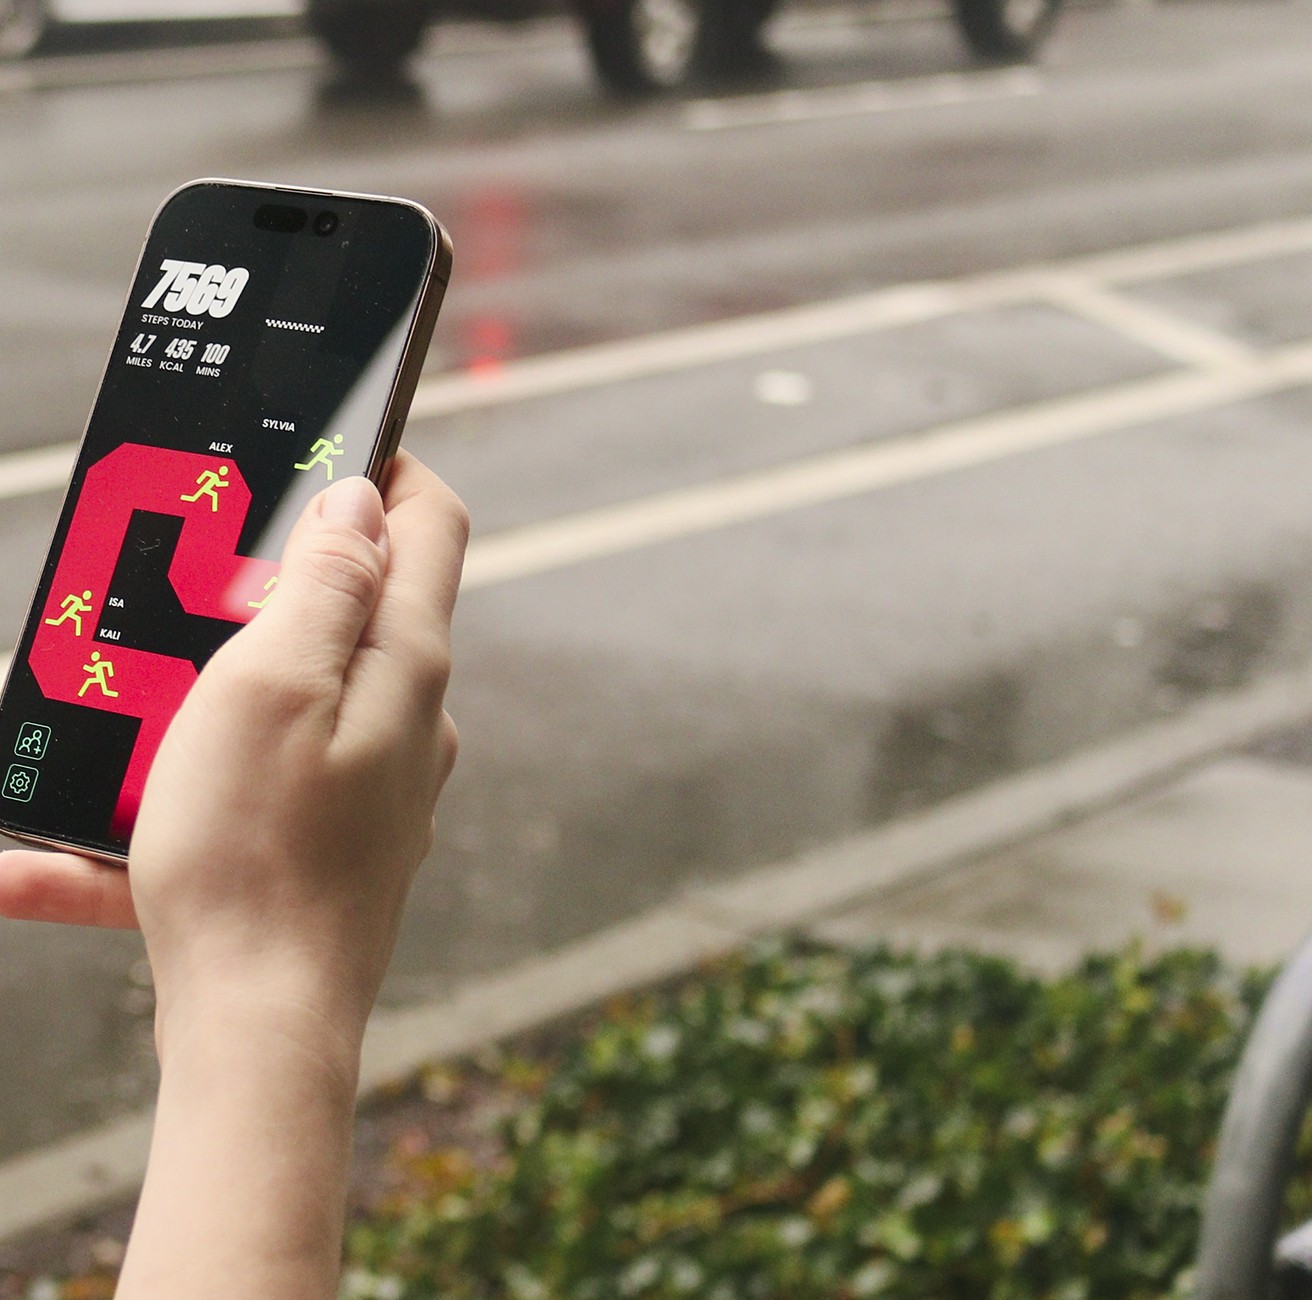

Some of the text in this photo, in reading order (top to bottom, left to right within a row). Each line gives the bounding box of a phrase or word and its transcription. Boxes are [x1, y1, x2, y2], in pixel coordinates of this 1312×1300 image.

[141, 259, 250, 319] 7569
[141, 313, 204, 330] STEPS TODAY
[129, 333, 231, 365] 4.7 435 100
[125, 355, 221, 378] MILES KCAL MINS
[261, 418, 295, 432] SYLVIA
[208, 441, 233, 453] ALEX
[108, 596, 124, 609] ISA
[99, 628, 121, 641] KALI
